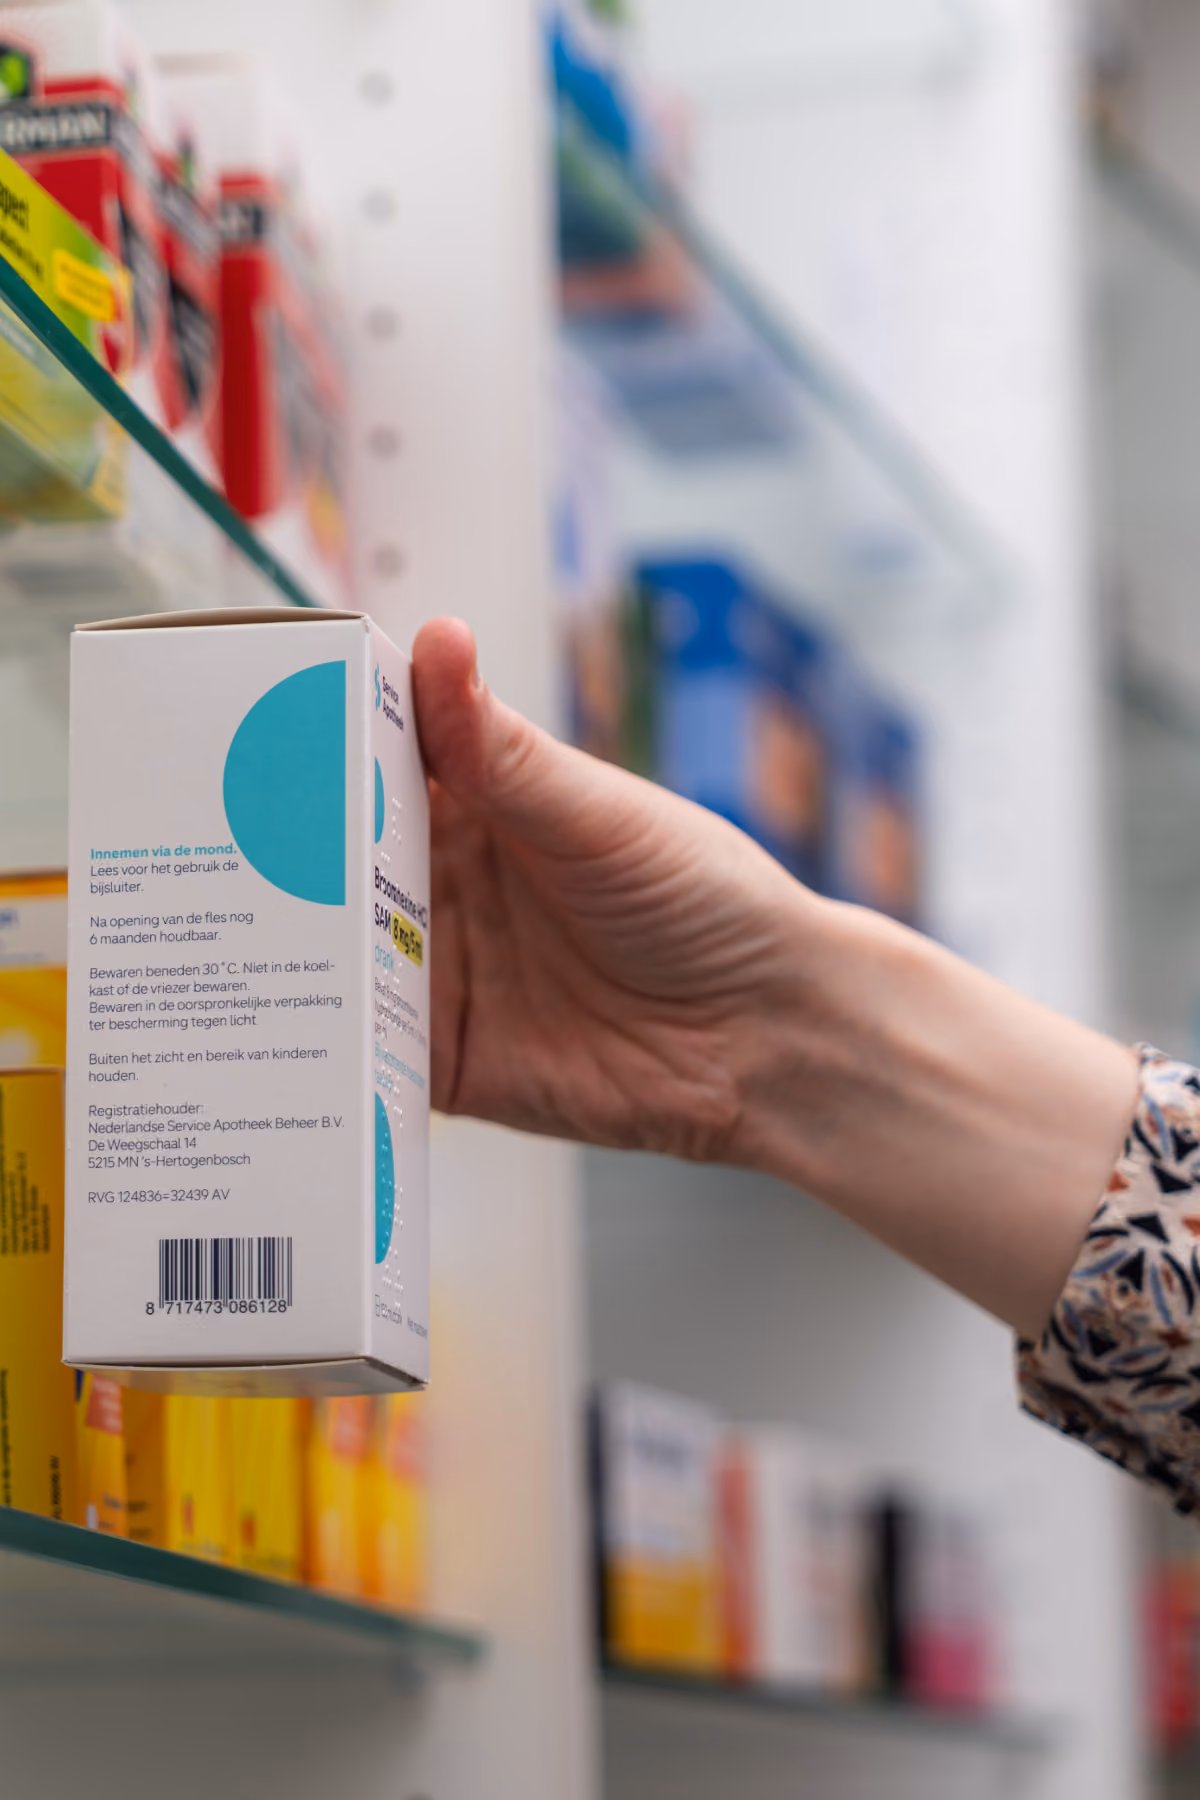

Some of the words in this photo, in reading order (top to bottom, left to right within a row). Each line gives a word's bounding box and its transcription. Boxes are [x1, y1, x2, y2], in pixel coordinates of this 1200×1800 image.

[91, 848, 148, 860] Innemen
[152, 845, 171, 857] via
[174, 844, 191, 856] de
[195, 843, 236, 855] mond.
[91, 865, 119, 877] Lees
[121, 866, 148, 875] voor
[151, 862, 171, 874] het
[174, 860, 220, 876] gebruik
[222, 860, 239, 871] de
[90, 881, 144, 896] bijsluiter.
[90, 916, 107, 928] Na
[110, 915, 159, 929] opening
[162, 916, 183, 924] van
[186, 912, 203, 924] de
[204, 911, 226, 923] fles
[229, 913, 253, 925] nog
[89, 933, 98, 945] 6
[100, 932, 156, 944] maanden
[160, 929, 221, 943] houdbaar.
[90, 968, 143, 979] Bewaren
[146, 964, 200, 977] beneden
[243, 962, 268, 974] Niet
[272, 961, 282, 972] in
[284, 960, 301, 972] de
[304, 959, 335, 972] koel-
[89, 984, 114, 997] kast
[117, 983, 131, 996] of
[132, 983, 148, 994] de
[151, 984, 190, 994] vriezer
[193, 981, 250, 992] bewaren.
[89, 1002, 142, 1013] Bewaren
[145, 1000, 155, 1012] in
[158, 1000, 175, 1011] de
[177, 996, 271, 1012] oorspronkelijke
[274, 994, 342, 1010] verpakking
[89, 1020, 106, 1031] ter
[109, 1017, 188, 1031] bescherming
[190, 1017, 227, 1030] tegen
[230, 1014, 258, 1026] licht
[89, 1053, 128, 1065] Buiten
[131, 1052, 152, 1064] het
[154, 1051, 184, 1063] zicht
[187, 1053, 202, 1062] en
[206, 1049, 245, 1062] bereik
[247, 1050, 269, 1060] van
[272, 1047, 327, 1059] kinderen
[89, 1070, 138, 1082] houden.
[89, 1121, 164, 1134] Nederlandse
[168, 1120, 211, 1131] Service
[213, 1118, 272, 1133] Apotheek
[275, 1117, 319, 1129] Beheer
[321, 1116, 345, 1128] B.V.
[88, 1140, 105, 1151] De
[107, 1137, 181, 1153] Weegschaal
[184, 1137, 196, 1148] 14
[88, 1156, 115, 1168] 5215
[118, 1156, 139, 1168] MN
[88, 1191, 115, 1203] RVG
[118, 1189, 209, 1202] 124836=32439
[212, 1188, 231, 1200] AV
[145, 1301, 155, 1315] 8
[165, 1301, 223, 1315] 717473
[229, 1300, 287, 1313] 086128
